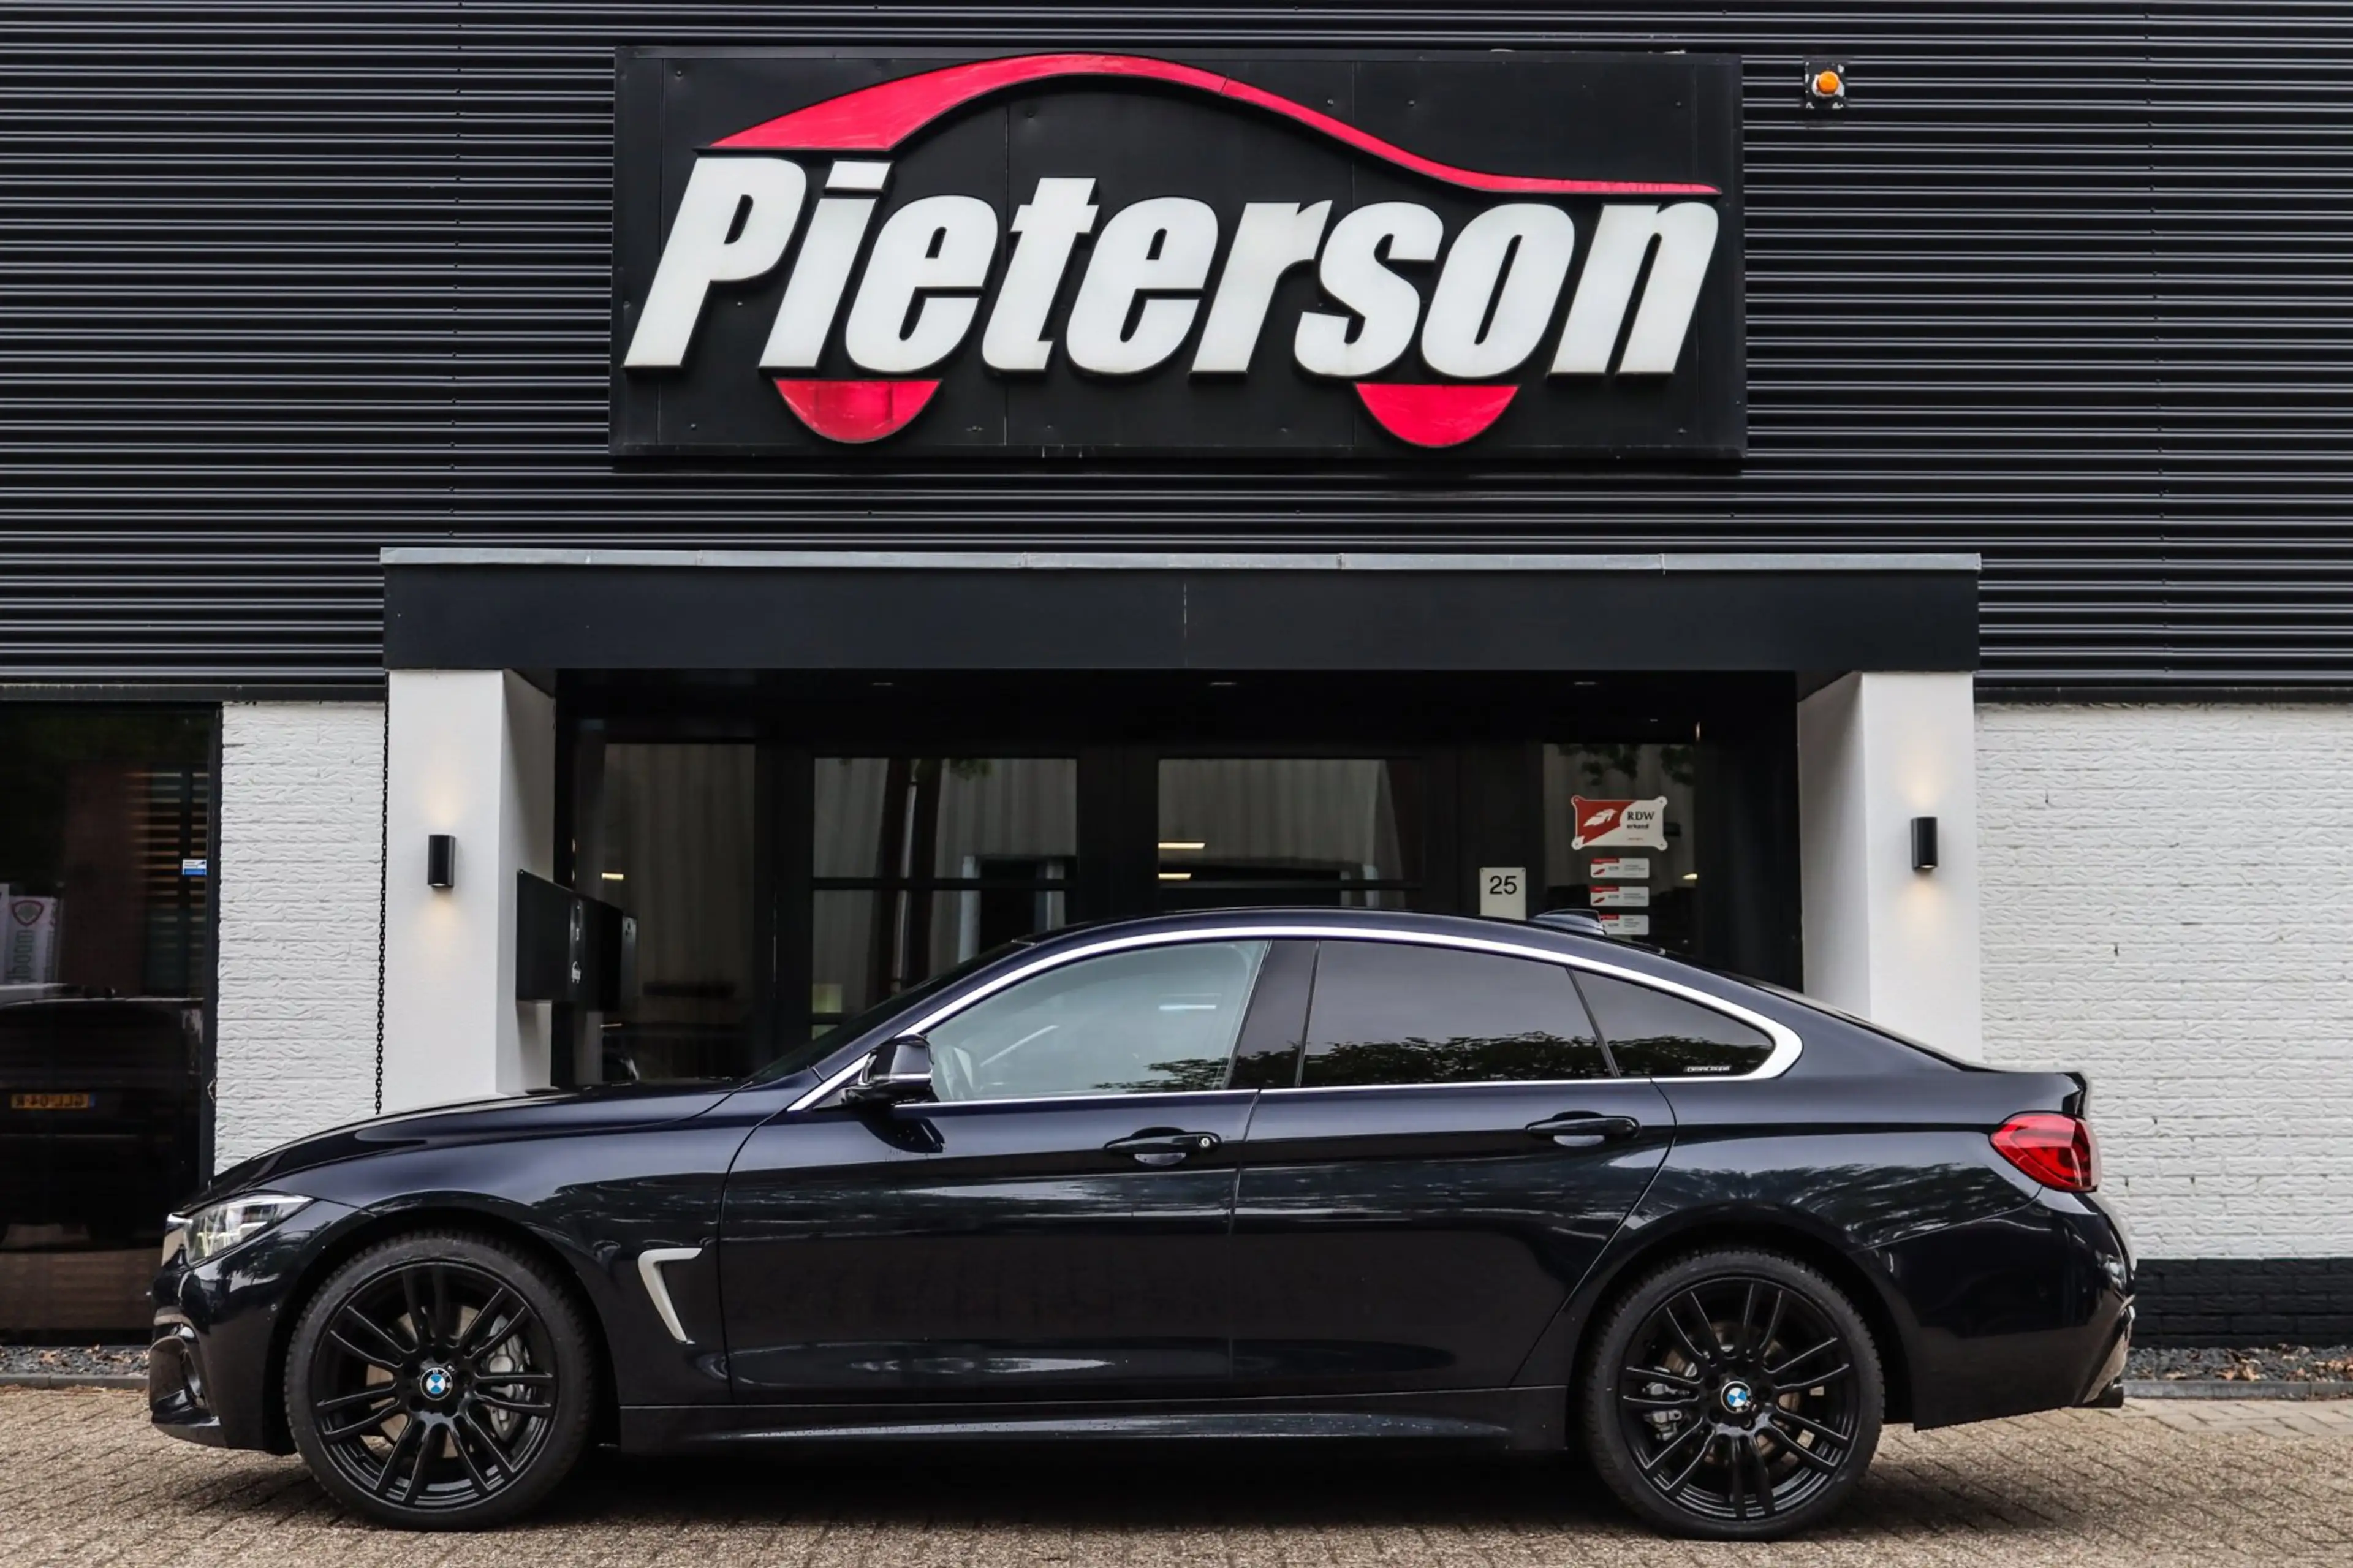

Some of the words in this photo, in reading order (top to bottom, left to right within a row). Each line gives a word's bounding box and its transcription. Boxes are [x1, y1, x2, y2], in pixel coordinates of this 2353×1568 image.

[624, 158, 1718, 377] Pieterson
[1627, 811, 1654, 820] RDW
[1490, 876, 1517, 895] 25
